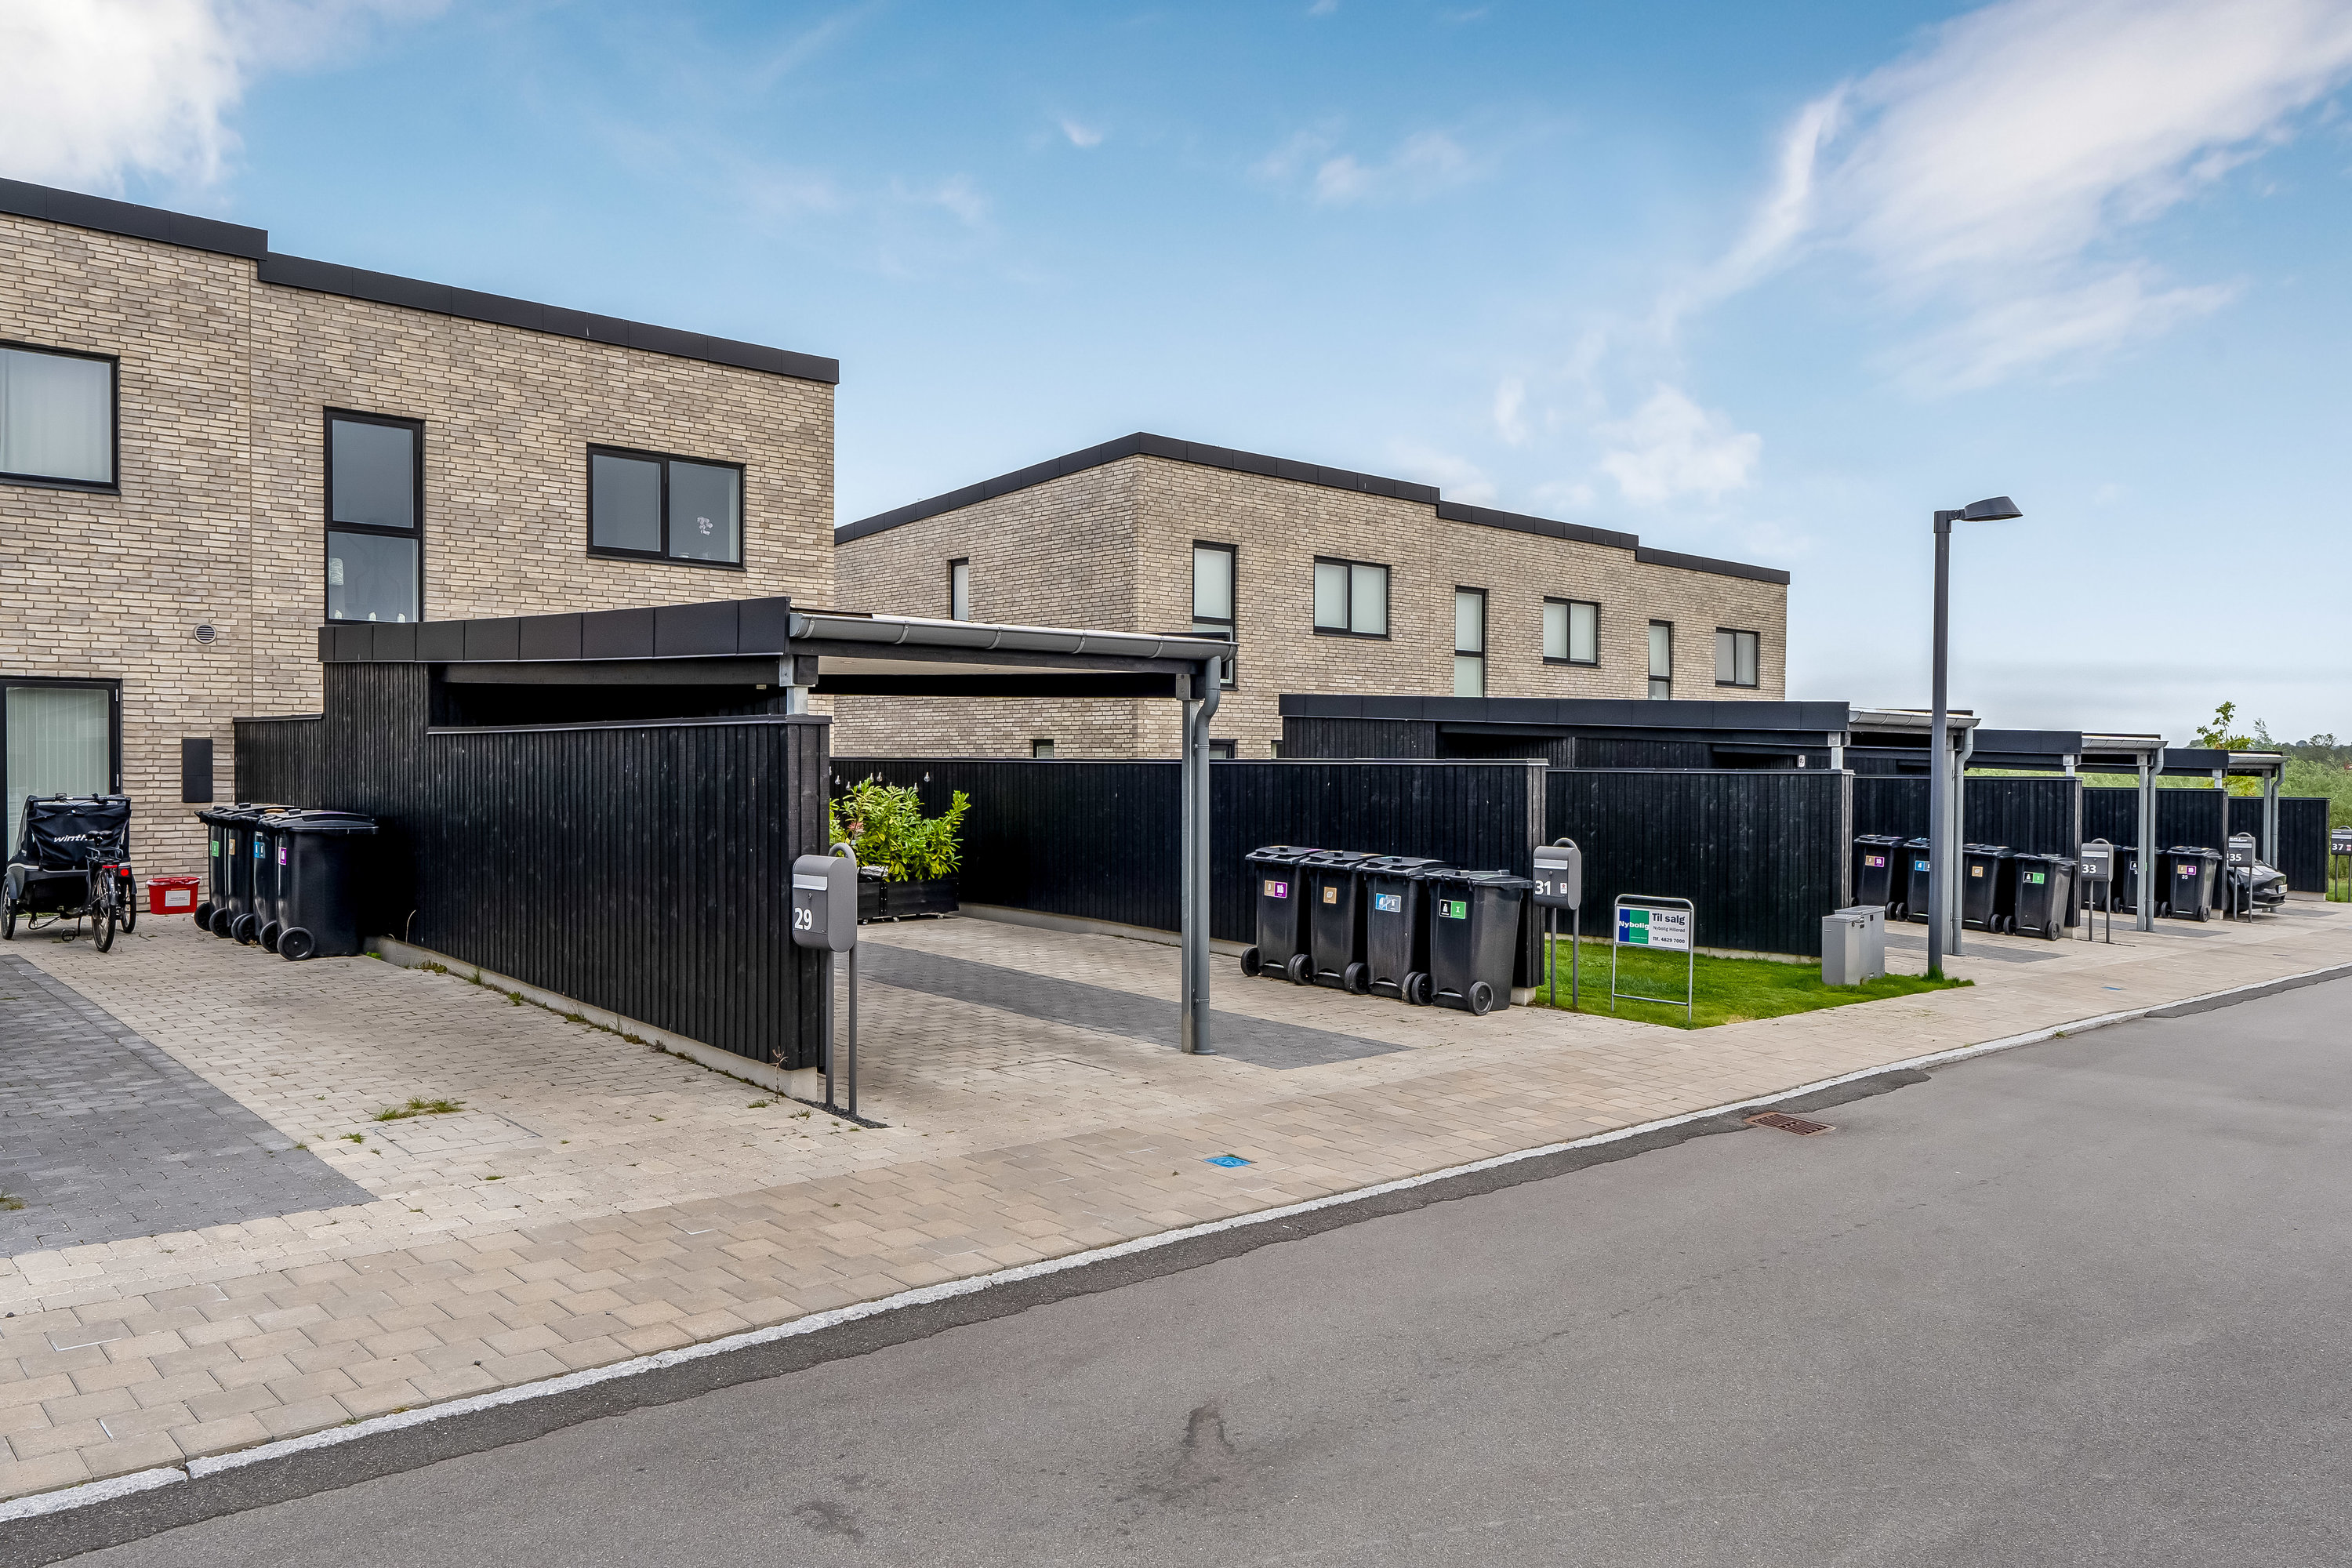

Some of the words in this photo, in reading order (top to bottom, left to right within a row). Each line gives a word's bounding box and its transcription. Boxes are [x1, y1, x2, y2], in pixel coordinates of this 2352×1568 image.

[2229, 853, 2242, 862] 35
[2082, 864, 2096, 874] 33
[1535, 880, 1551, 895] 31
[794, 907, 812, 931] 29
[1652, 913, 1662, 922] Til
[1664, 915, 1686, 926] salg
[1619, 920, 1650, 931] Nybolig
